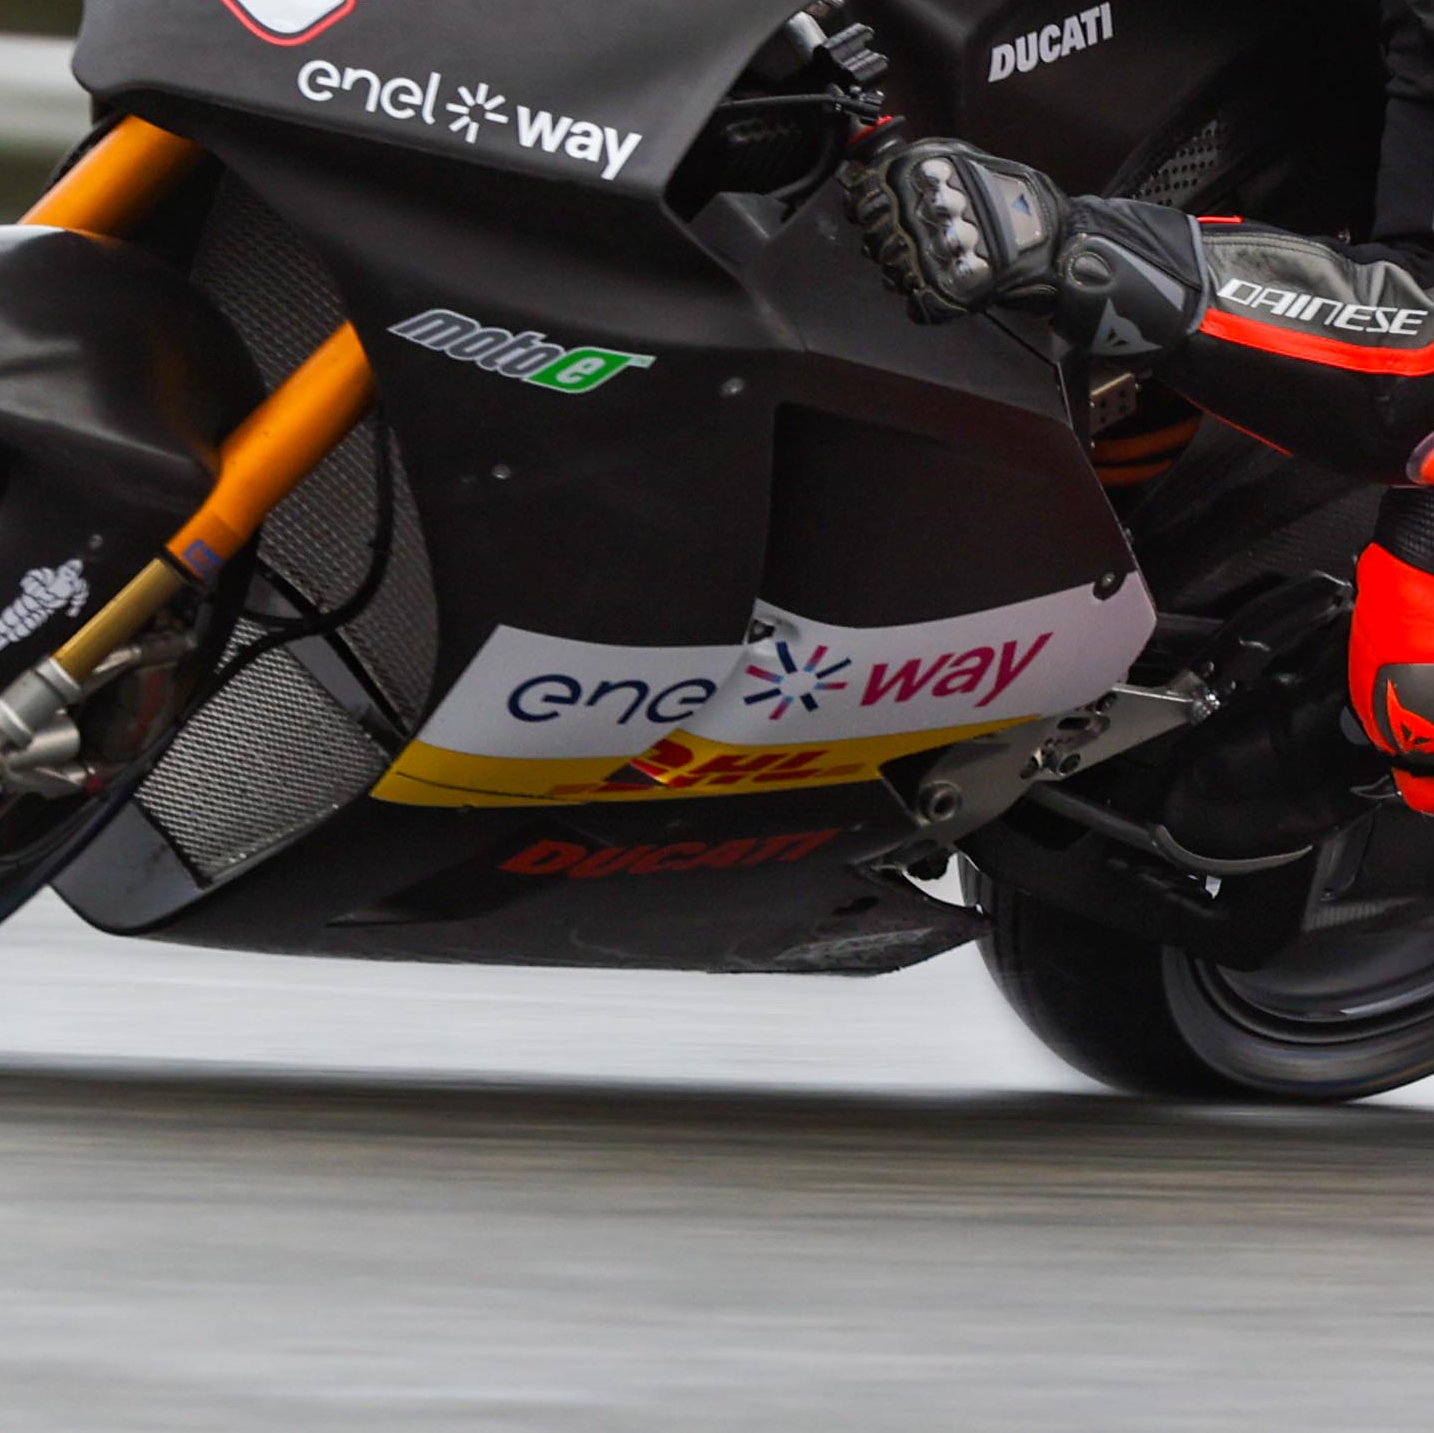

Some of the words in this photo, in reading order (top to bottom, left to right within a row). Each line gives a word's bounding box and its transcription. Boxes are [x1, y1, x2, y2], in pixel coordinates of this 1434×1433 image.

[988, 2, 1114, 82] DUCATI
[297, 60, 440, 124] enel
[516, 106, 642, 179] way
[1217, 278, 1428, 335] DAINESE
[860, 632, 1053, 707] way
[498, 829, 841, 878] DUCATI
